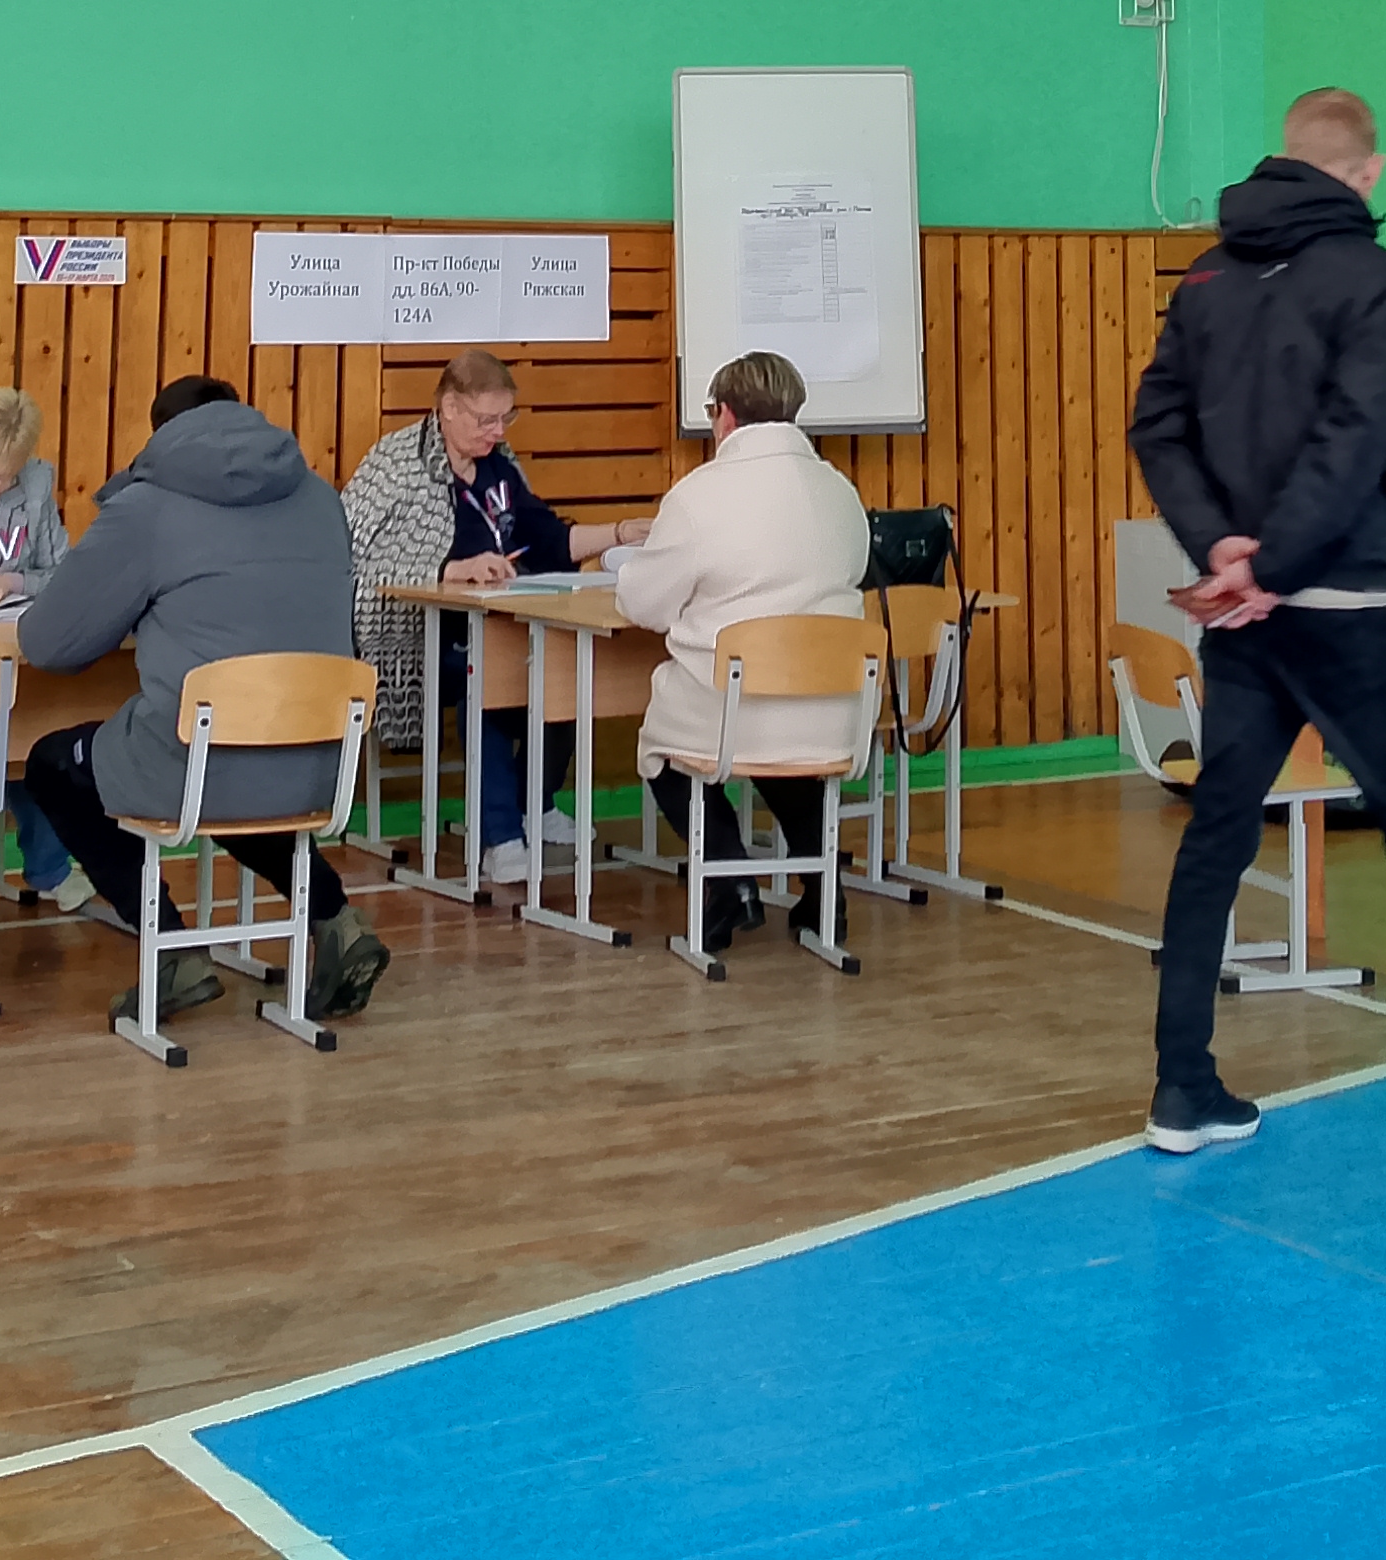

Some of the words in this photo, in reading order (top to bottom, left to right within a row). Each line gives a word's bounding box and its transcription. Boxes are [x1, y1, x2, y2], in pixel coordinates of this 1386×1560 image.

[65, 251, 123, 261] ПРЕЗИДЕНТА
[290, 254, 340, 272] Улица
[393, 255, 438, 274] Пр-кт
[443, 256, 500, 273] Победы
[531, 256, 577, 273] Улица
[268, 281, 360, 300] Урожайная
[456, 281, 480, 297] 90-
[394, 308, 432, 323] 124А
